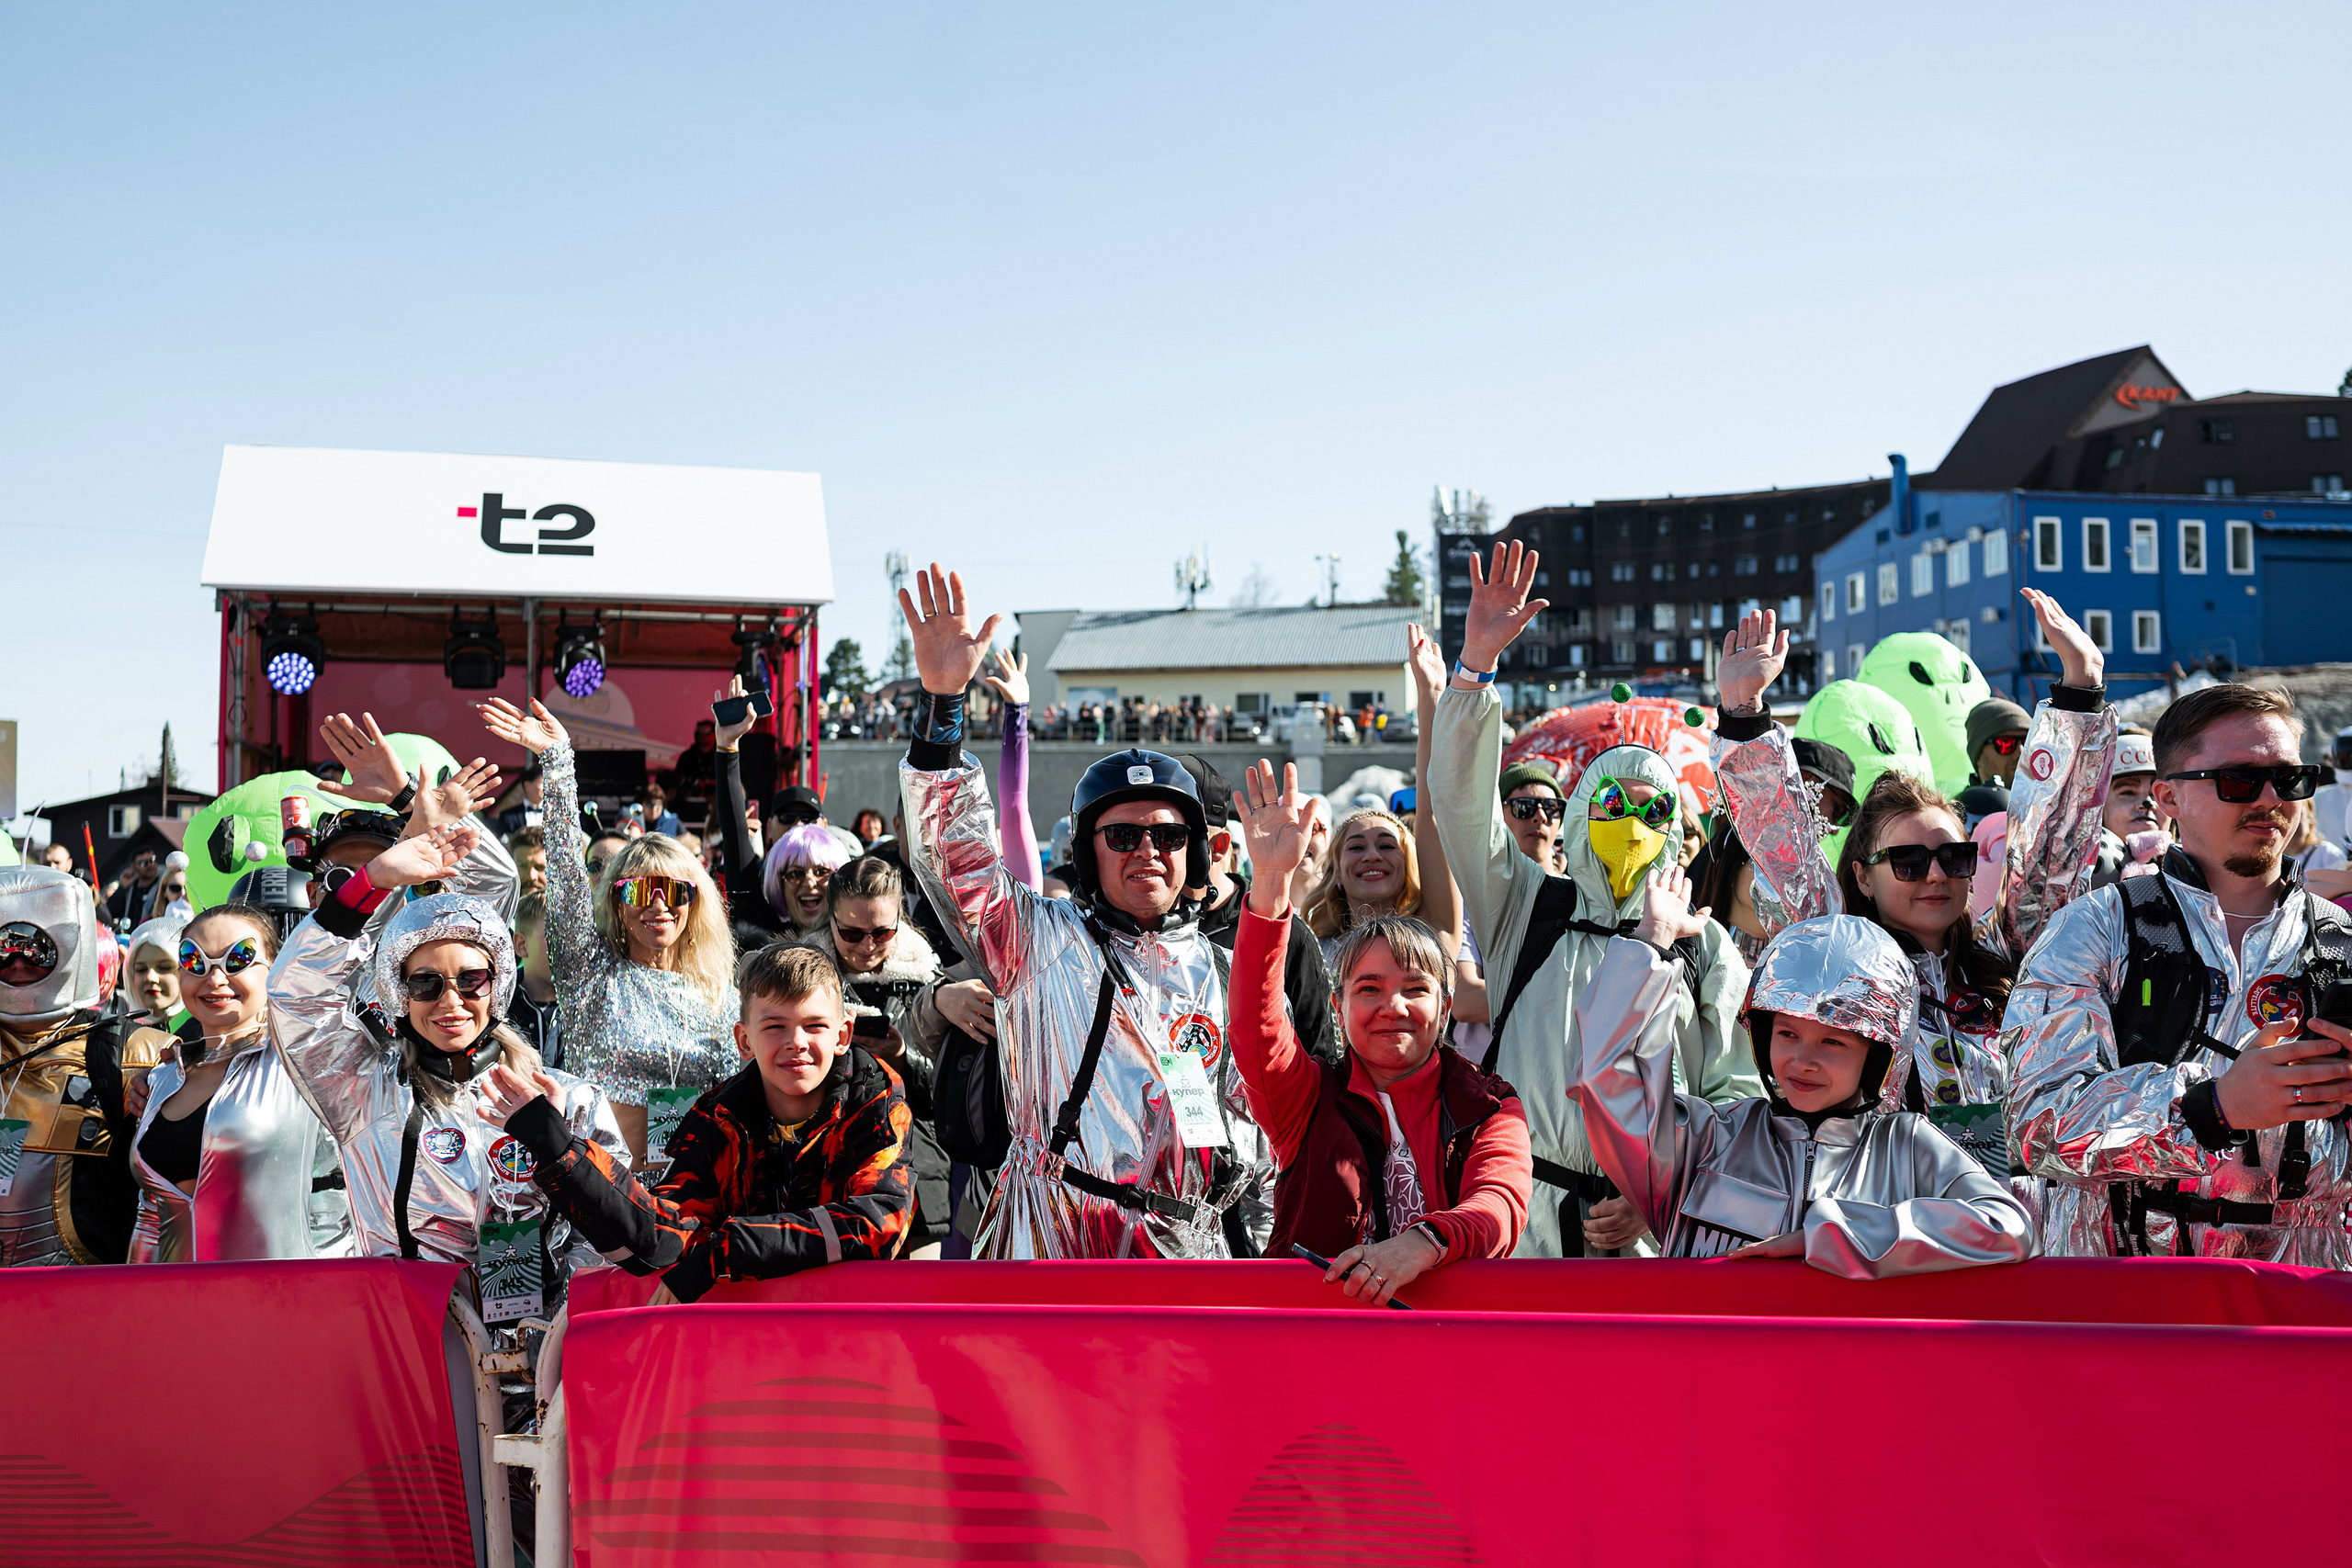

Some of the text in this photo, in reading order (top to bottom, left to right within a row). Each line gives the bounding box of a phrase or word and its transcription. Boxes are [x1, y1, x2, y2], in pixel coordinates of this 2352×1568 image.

[481, 492, 595, 556] t2
[1172, 1088, 1204, 1098] купер
[1184, 1106, 1204, 1118] 344
[488, 1256, 534, 1269] купер
[500, 1277, 525, 1291] 345
